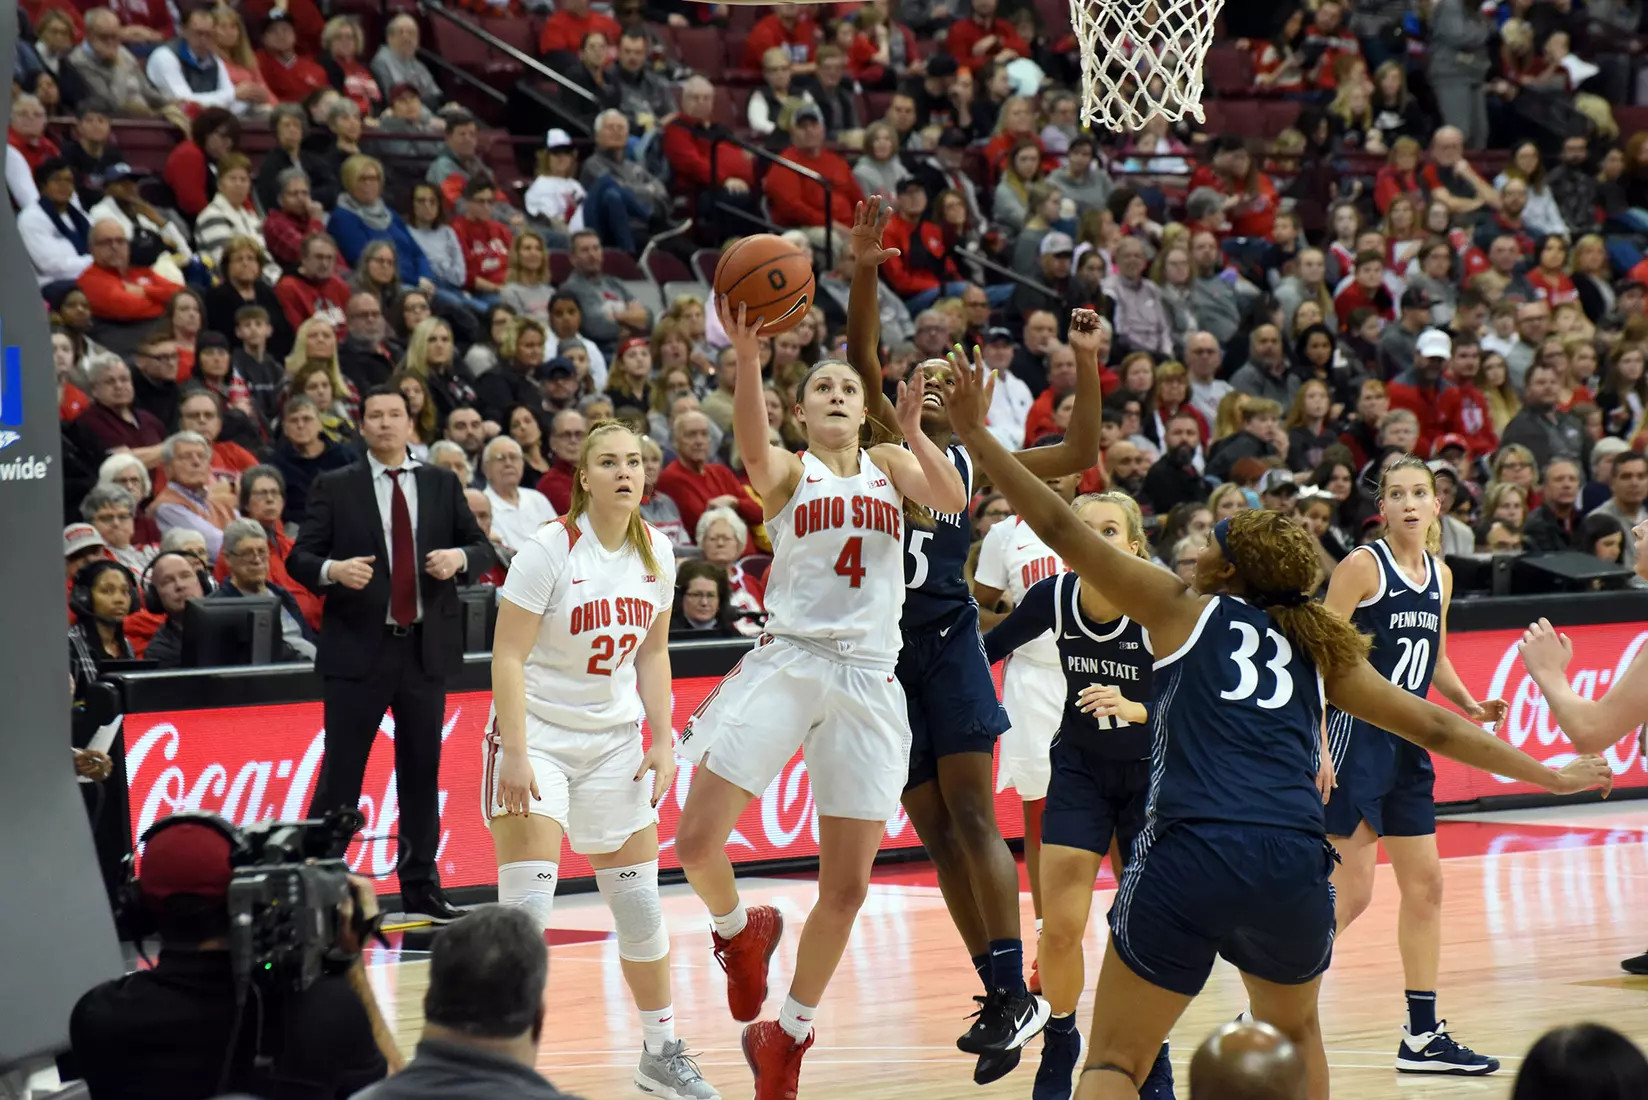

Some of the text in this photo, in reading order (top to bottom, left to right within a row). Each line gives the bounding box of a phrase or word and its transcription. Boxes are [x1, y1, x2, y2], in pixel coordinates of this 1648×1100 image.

[794, 495, 900, 542] OHIO STATE
[833, 536, 866, 588] 4
[905, 529, 934, 590] 5
[1021, 555, 1057, 590] OHIO
[570, 598, 611, 636] OHIO
[1389, 611, 1439, 633] PENN STATE
[1068, 655, 1140, 681] PENN STATE
[1220, 620, 1294, 710] 33
[1391, 637, 1430, 691] 20
